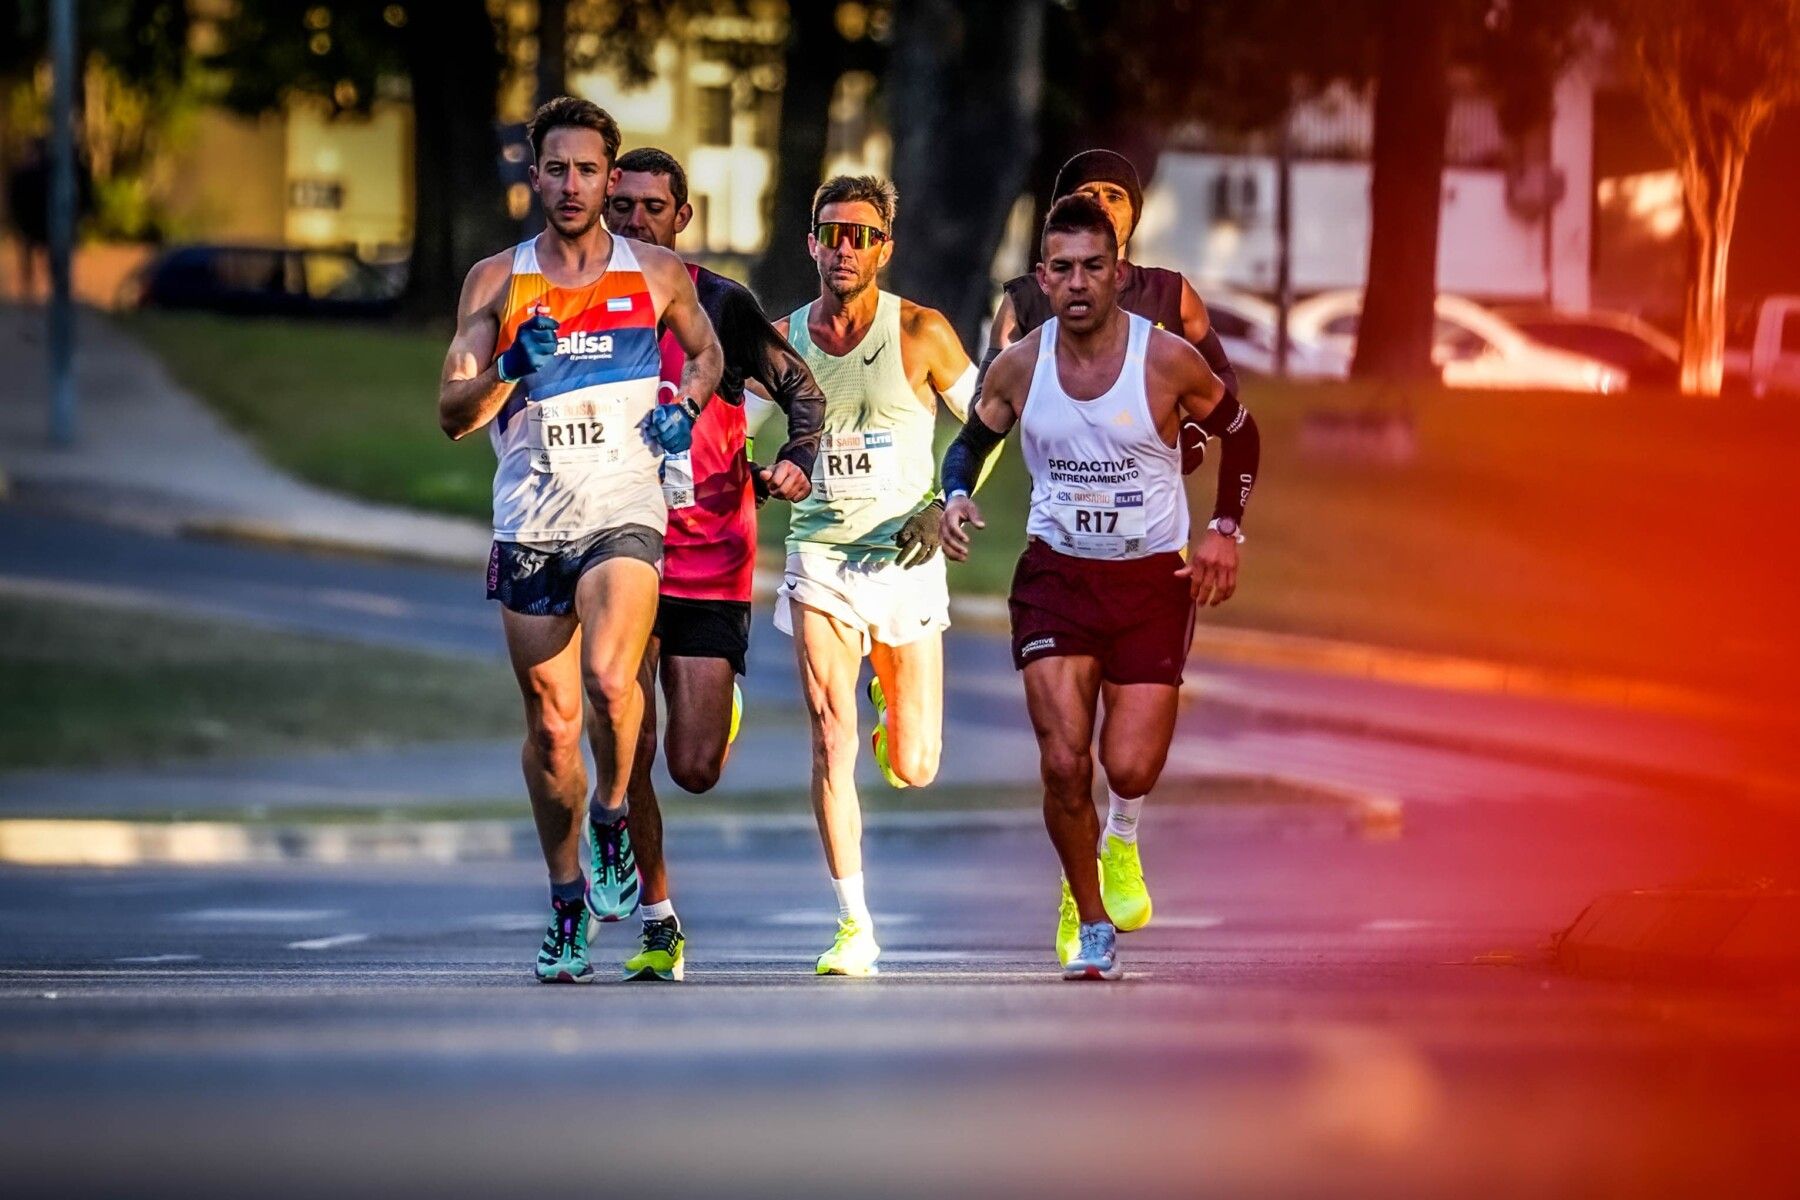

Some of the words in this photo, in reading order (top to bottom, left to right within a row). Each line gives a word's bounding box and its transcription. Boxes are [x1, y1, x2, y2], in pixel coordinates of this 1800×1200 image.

[554, 331, 613, 356] alisa
[537, 405, 559, 418] 42K
[547, 421, 606, 447] R112
[865, 433, 892, 446] ELITE
[827, 452, 872, 476] R14
[1048, 458, 1136, 473] PROACTIVE
[1050, 470, 1139, 484] ENTRENAMIENTO
[1056, 491, 1072, 502] 42K
[1115, 494, 1142, 504] ELITE
[1076, 510, 1119, 534] R17
